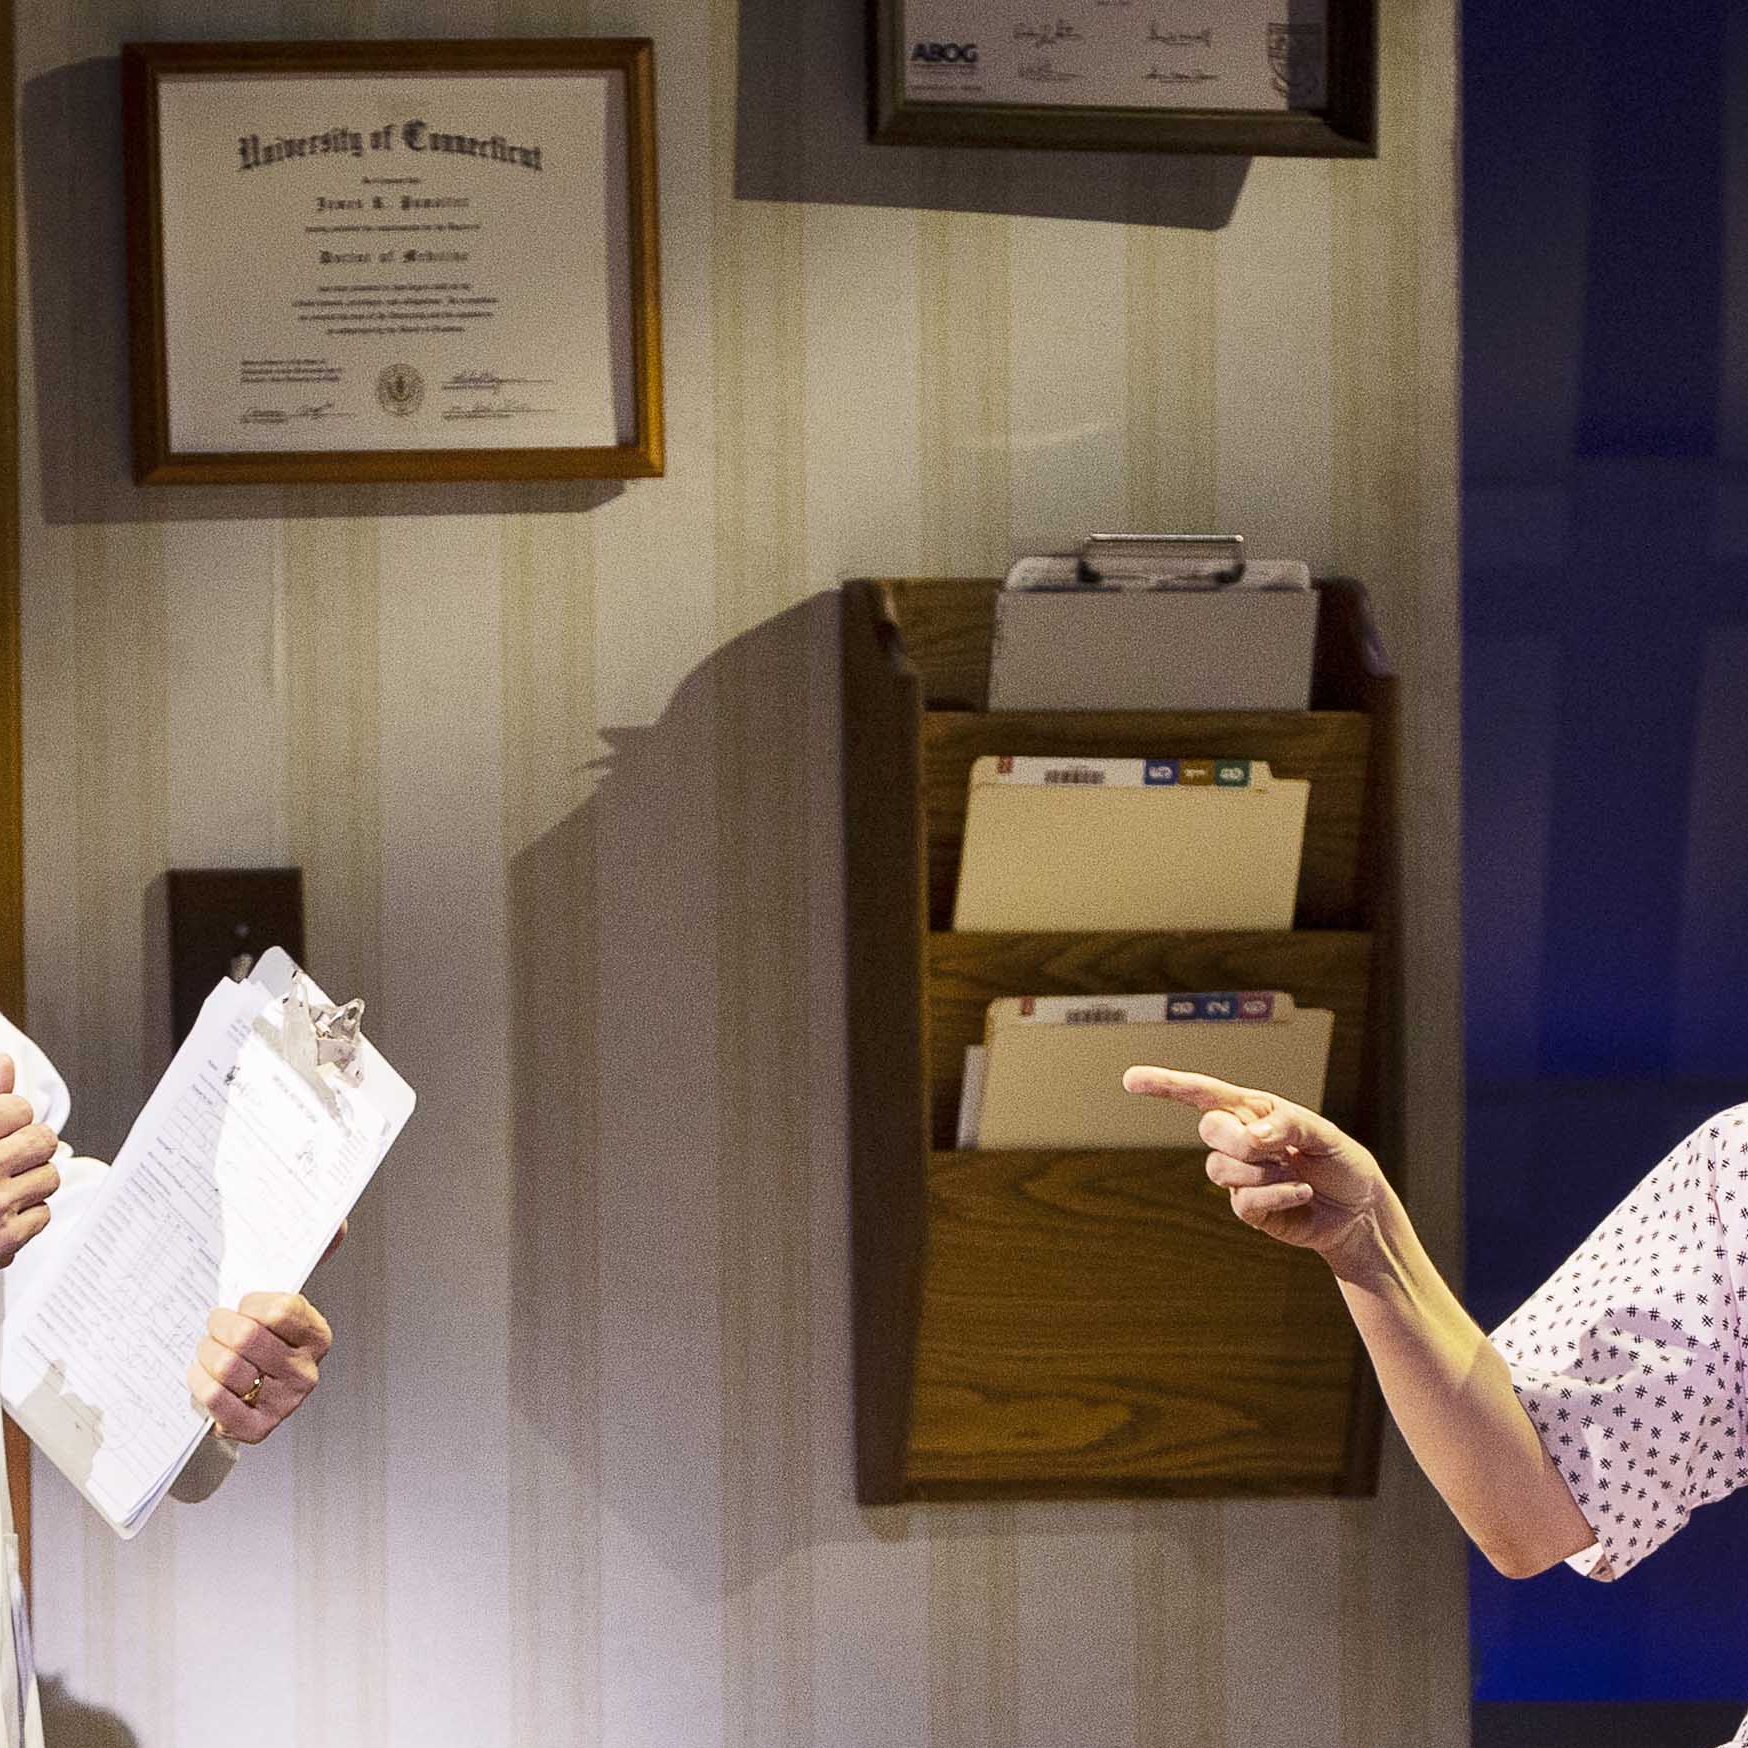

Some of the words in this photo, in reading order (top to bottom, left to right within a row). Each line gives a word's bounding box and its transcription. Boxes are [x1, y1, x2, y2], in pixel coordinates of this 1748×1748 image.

[912, 42, 977, 63] ABOG
[238, 127, 362, 170] University
[370, 125, 396, 150] of
[402, 119, 542, 171] Connecticut
